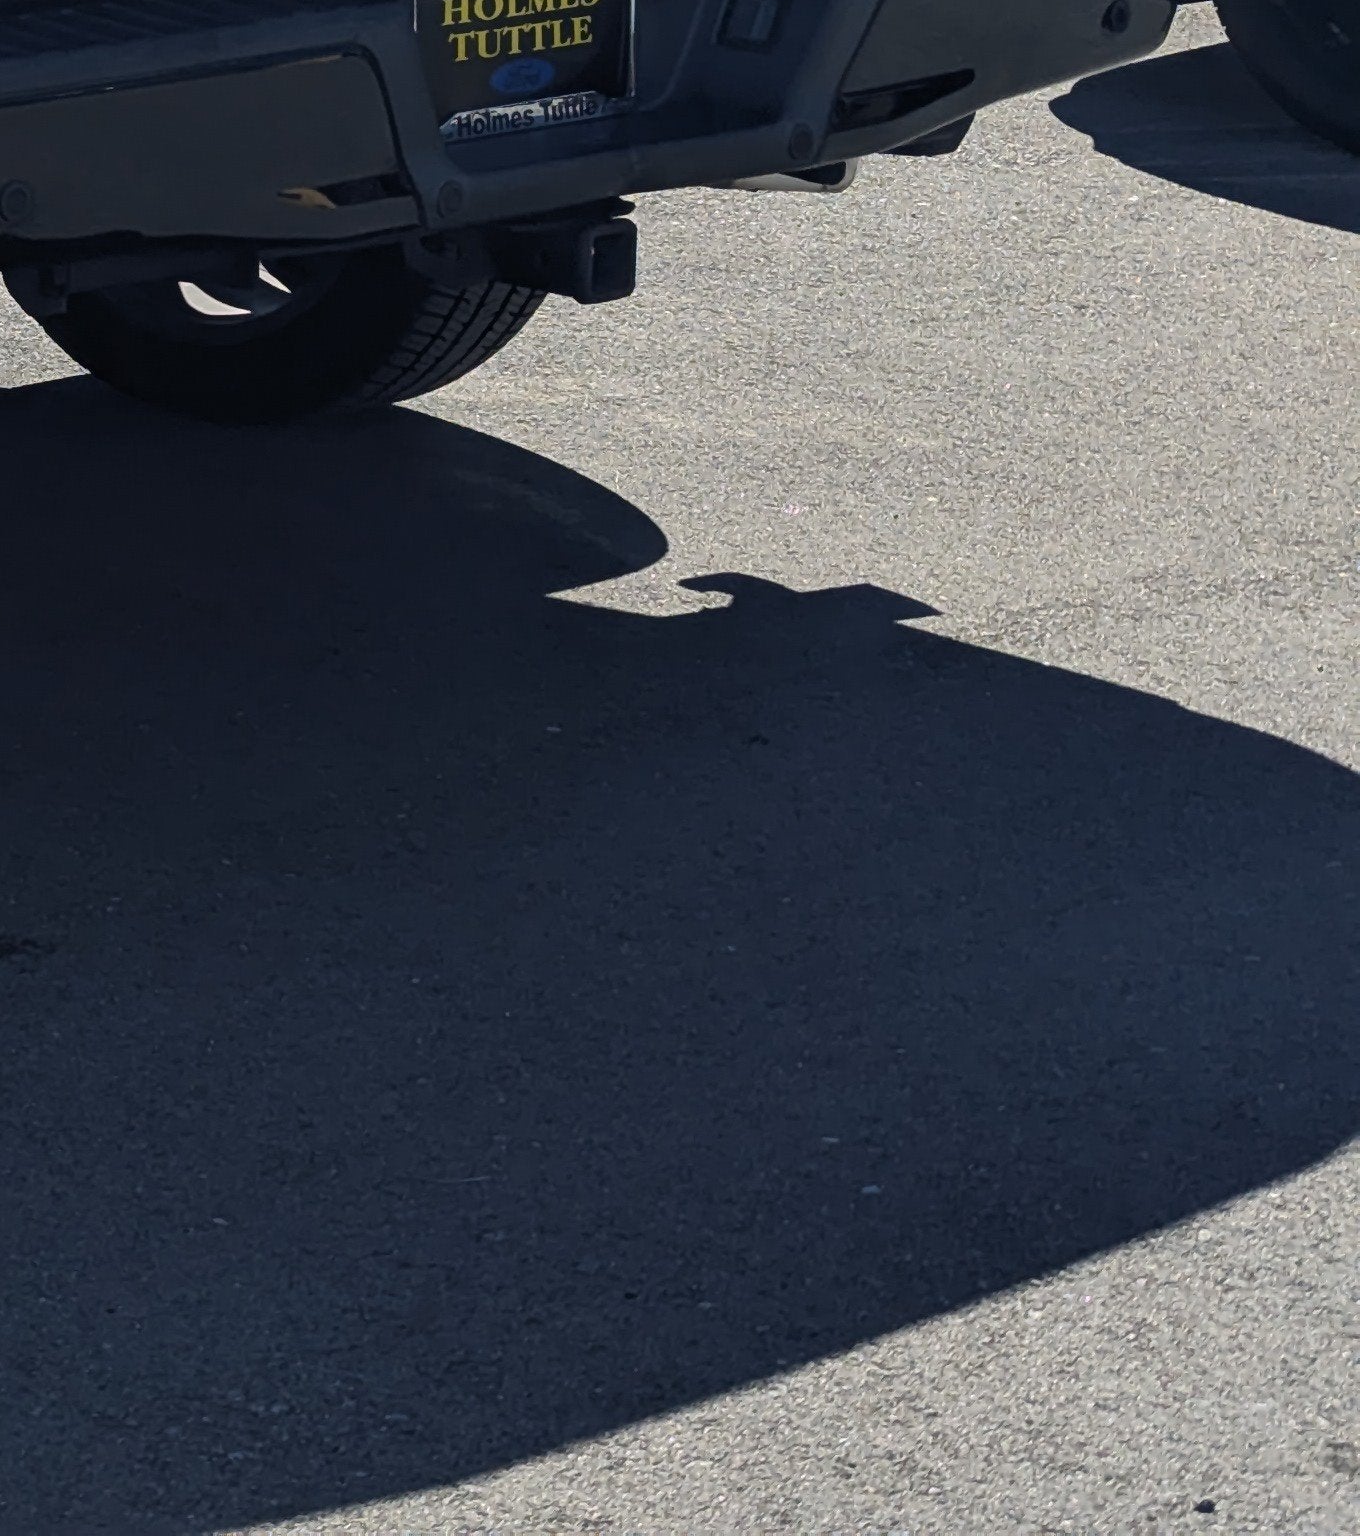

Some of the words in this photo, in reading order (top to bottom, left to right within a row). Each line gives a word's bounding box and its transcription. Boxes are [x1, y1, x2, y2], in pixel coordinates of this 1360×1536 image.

[448, 15, 594, 63] TUTTLE
[456, 106, 534, 138] Holmes
[538, 95, 598, 124] Tuttle
